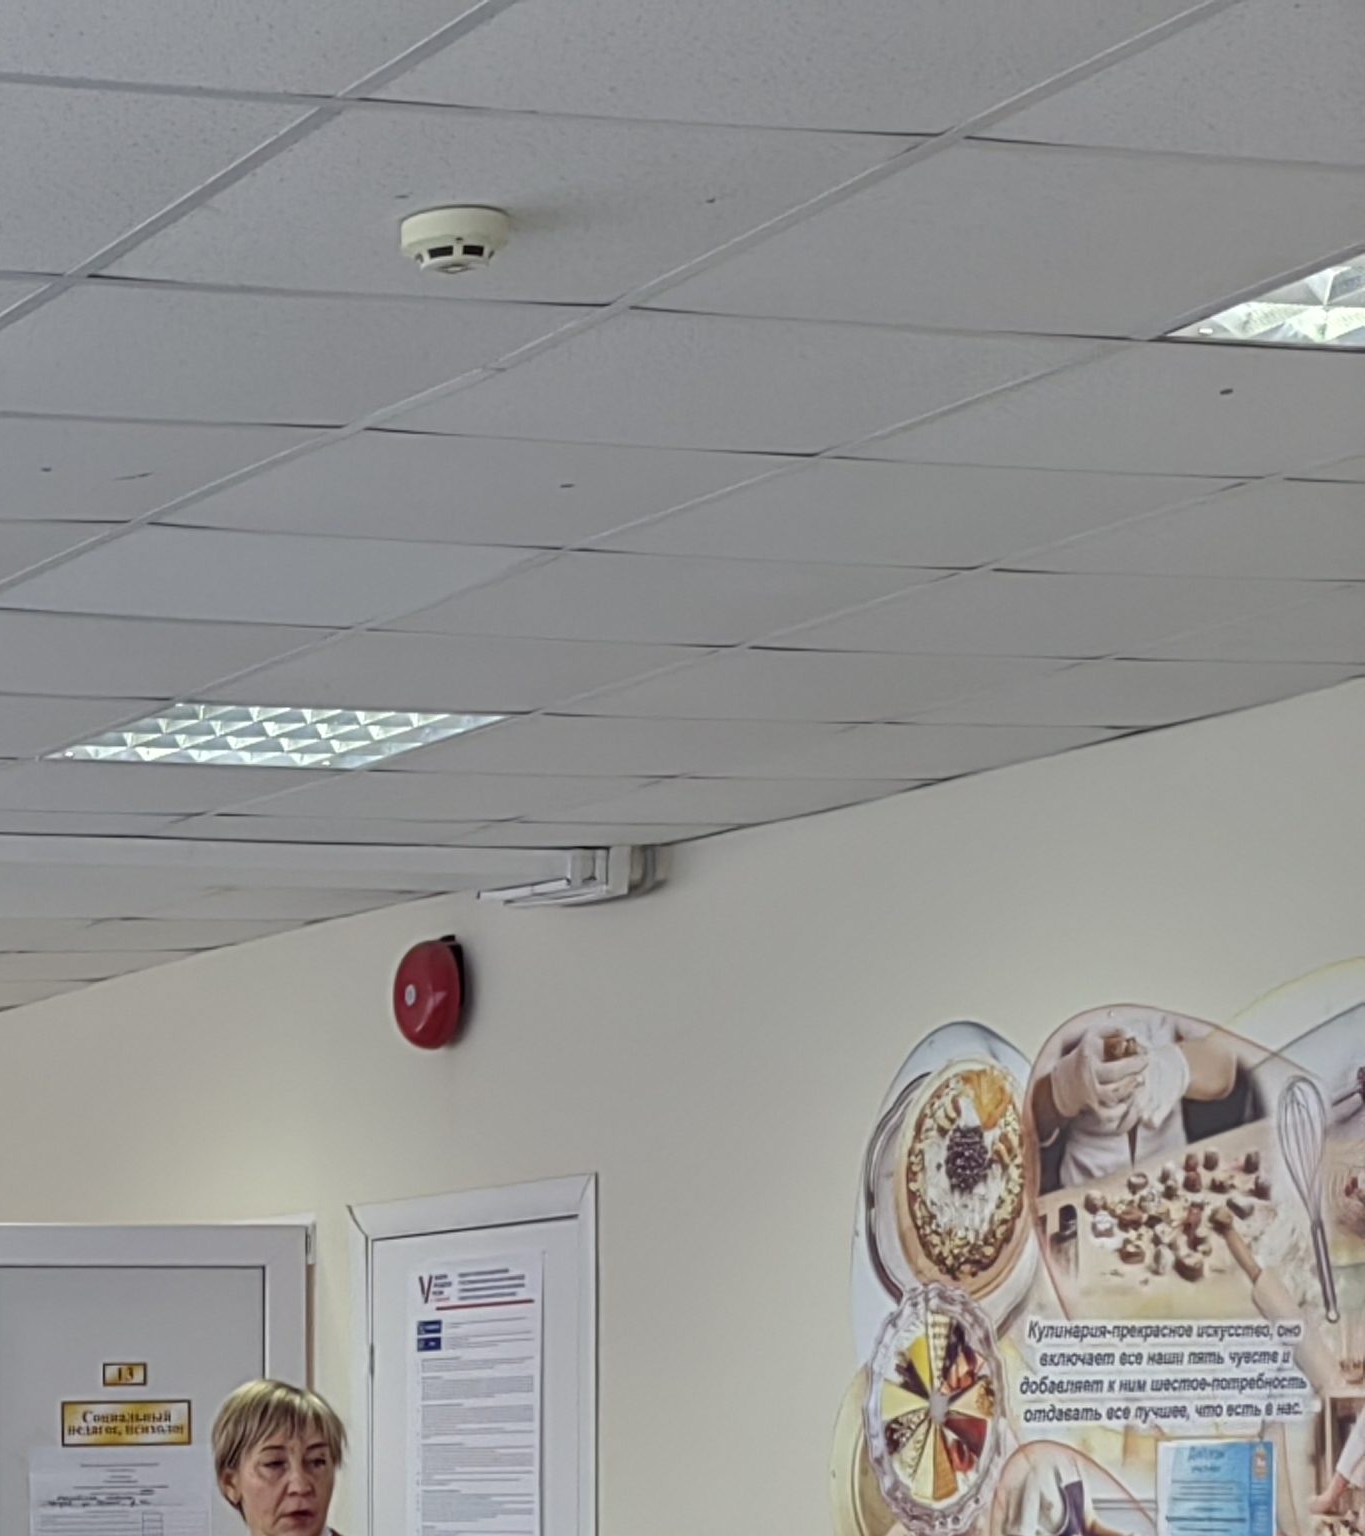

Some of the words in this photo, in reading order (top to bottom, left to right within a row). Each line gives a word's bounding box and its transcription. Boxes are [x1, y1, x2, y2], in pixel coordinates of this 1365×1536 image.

[1197, 1325, 1273, 1341] искусство,
[1277, 1324, 1302, 1338] оно
[1039, 1352, 1115, 1366] включает
[1147, 1351, 1185, 1365] наши
[1188, 1350, 1225, 1365] пять
[1282, 1351, 1291, 1363] и
[1020, 1376, 1104, 1394] добавляет
[1107, 1380, 1117, 1393] к
[1119, 1379, 1147, 1393] ним
[82, 1410, 172, 1423] Социальный
[1024, 1403, 1102, 1422] отдавать
[1134, 1405, 1190, 1424] лучшее,
[1195, 1404, 1223, 1418] что
[1226, 1404, 1262, 1418] есть
[1265, 1402, 1274, 1416] в
[1277, 1402, 1303, 1416] нас.
[68, 1424, 123, 1437] педагог,
[125, 1423, 184, 1436] психолог
